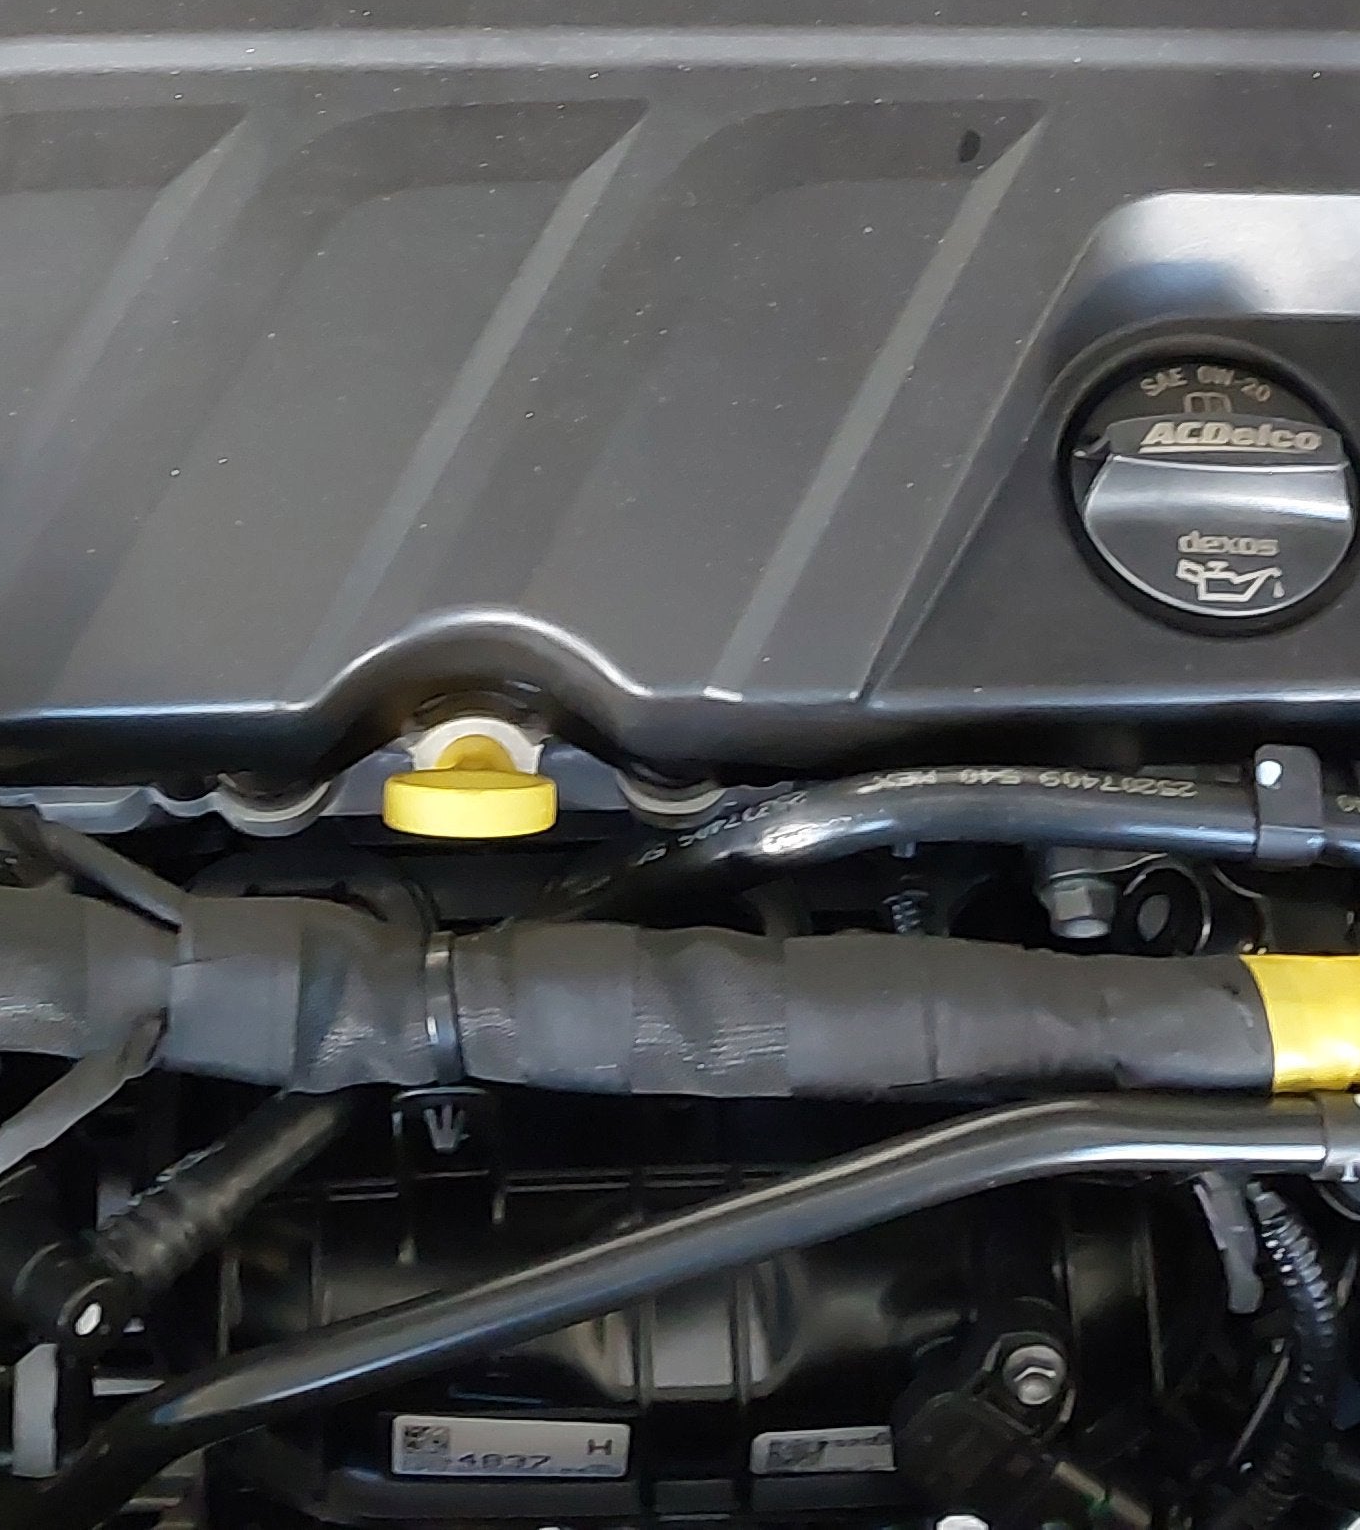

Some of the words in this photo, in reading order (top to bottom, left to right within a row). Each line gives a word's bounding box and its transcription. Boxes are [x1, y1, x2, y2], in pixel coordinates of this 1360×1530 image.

[1140, 367, 1188, 397] SAE
[1141, 422, 1322, 451] ACDelco
[1178, 530, 1281, 558] dexos
